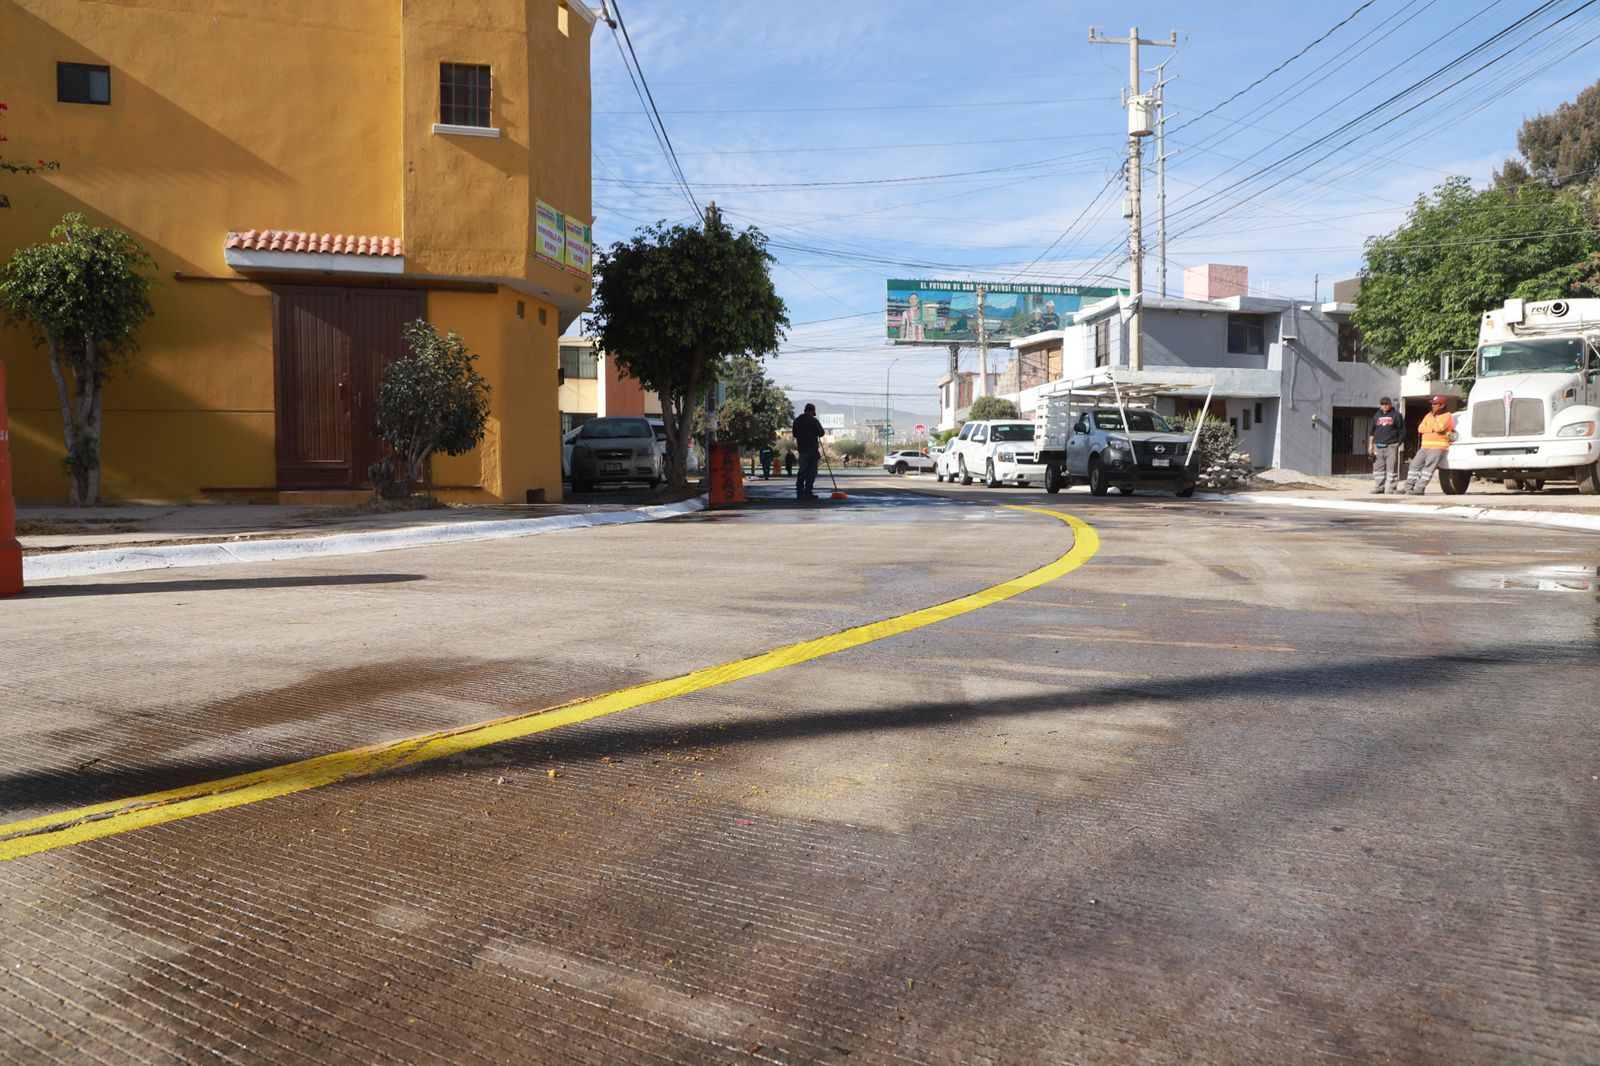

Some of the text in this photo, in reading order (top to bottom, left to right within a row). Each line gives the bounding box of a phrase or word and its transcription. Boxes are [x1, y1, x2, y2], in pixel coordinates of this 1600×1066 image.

[929, 282, 952, 290] FUTURO
[953, 283, 961, 291] DE
[963, 283, 975, 291] SAN
[1013, 285, 1029, 293] TIENE
[1044, 286, 1062, 294] NUEVA
